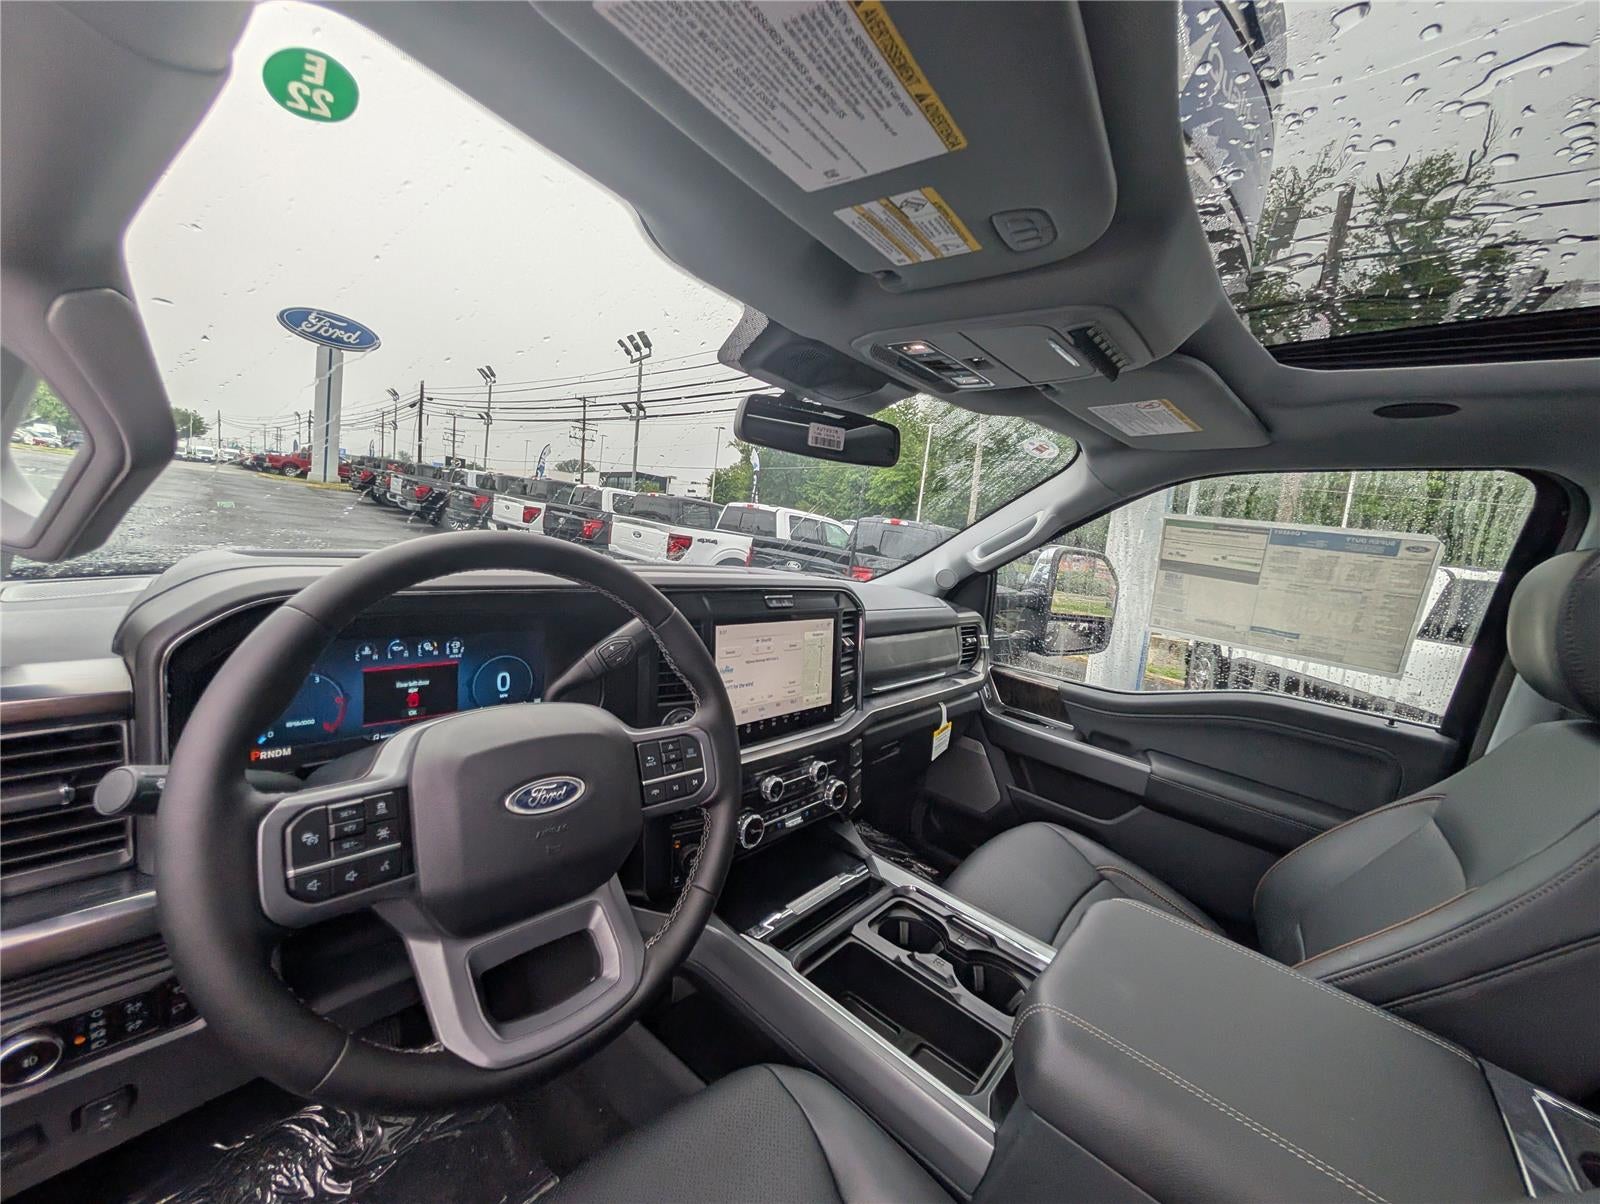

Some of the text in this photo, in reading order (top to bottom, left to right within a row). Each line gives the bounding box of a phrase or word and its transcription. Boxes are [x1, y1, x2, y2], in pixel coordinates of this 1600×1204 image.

[299, 311, 361, 344] Ford
[496, 671, 511, 692] 0
[528, 783, 568, 808] Ford
